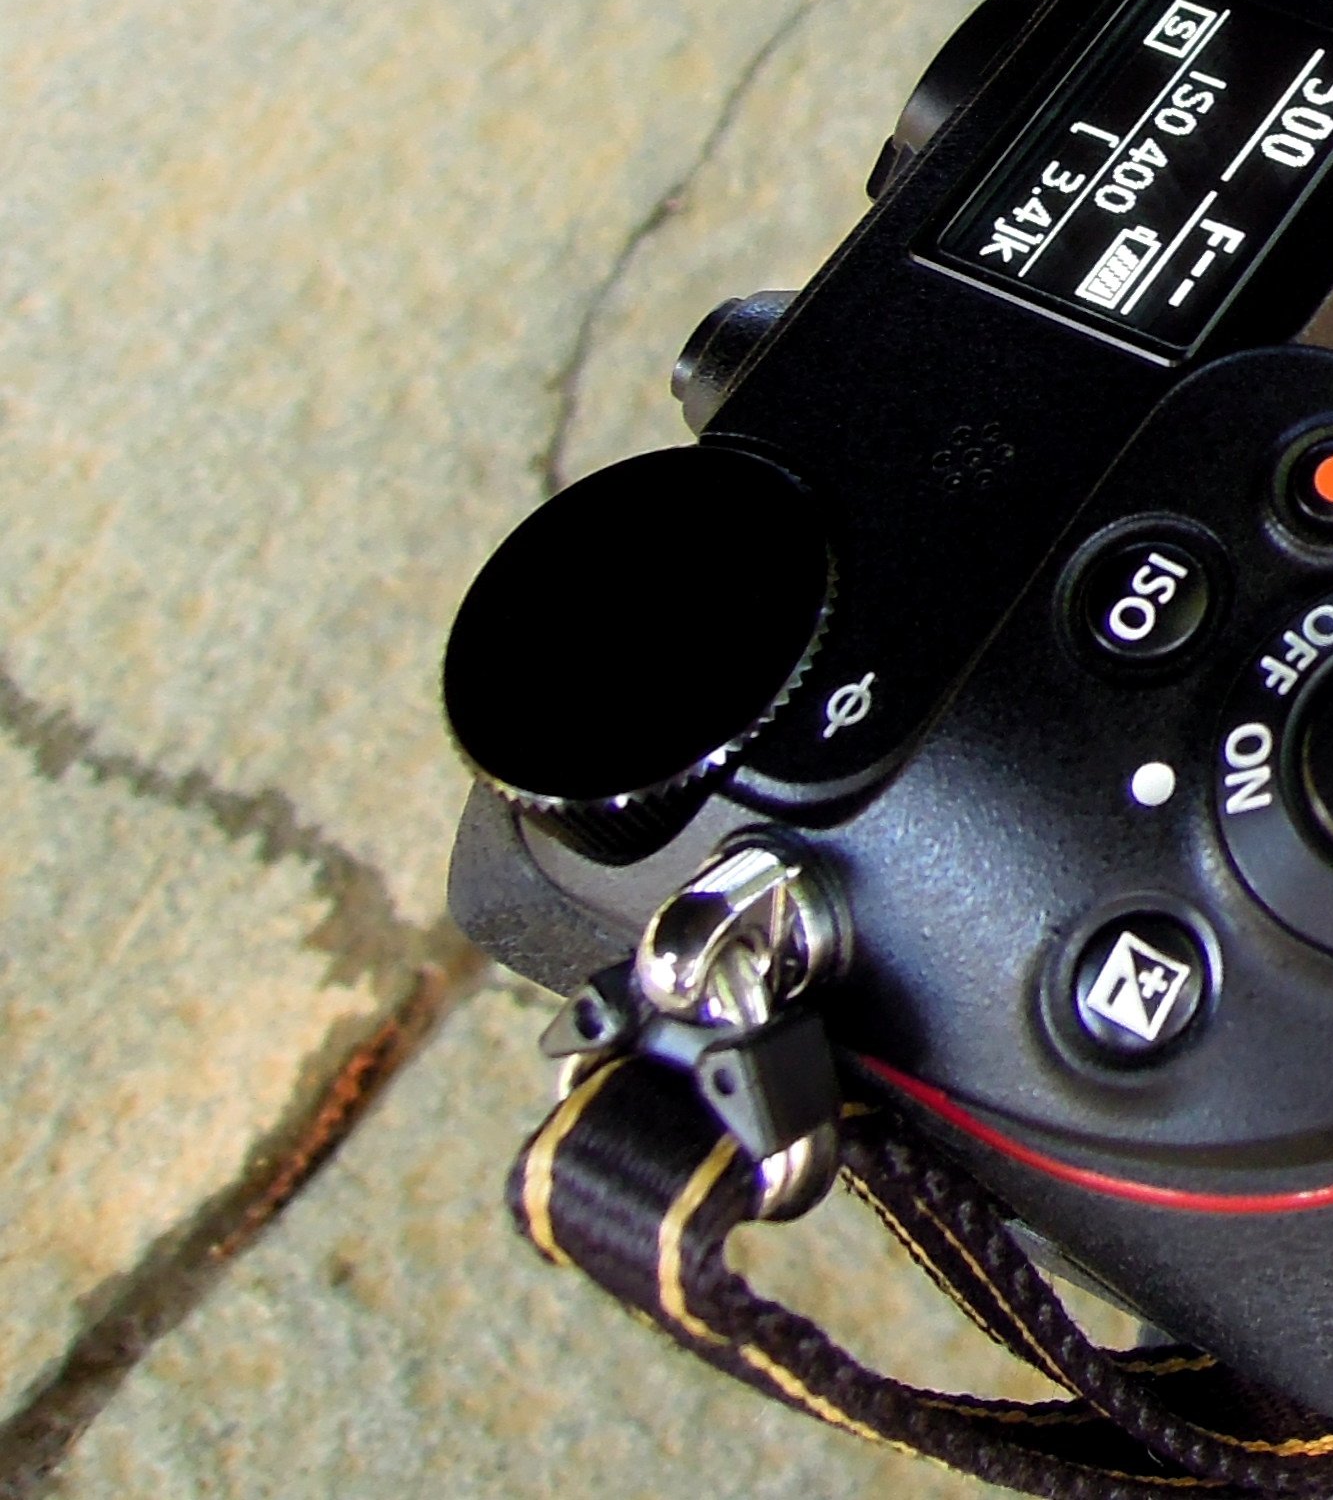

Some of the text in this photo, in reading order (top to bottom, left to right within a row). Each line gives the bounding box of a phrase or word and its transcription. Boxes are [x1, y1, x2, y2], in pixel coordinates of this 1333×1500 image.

[1094, 70, 1227, 215] ISO 400
[1109, 552, 1188, 640] ISO
[1224, 722, 1272, 814] ON
